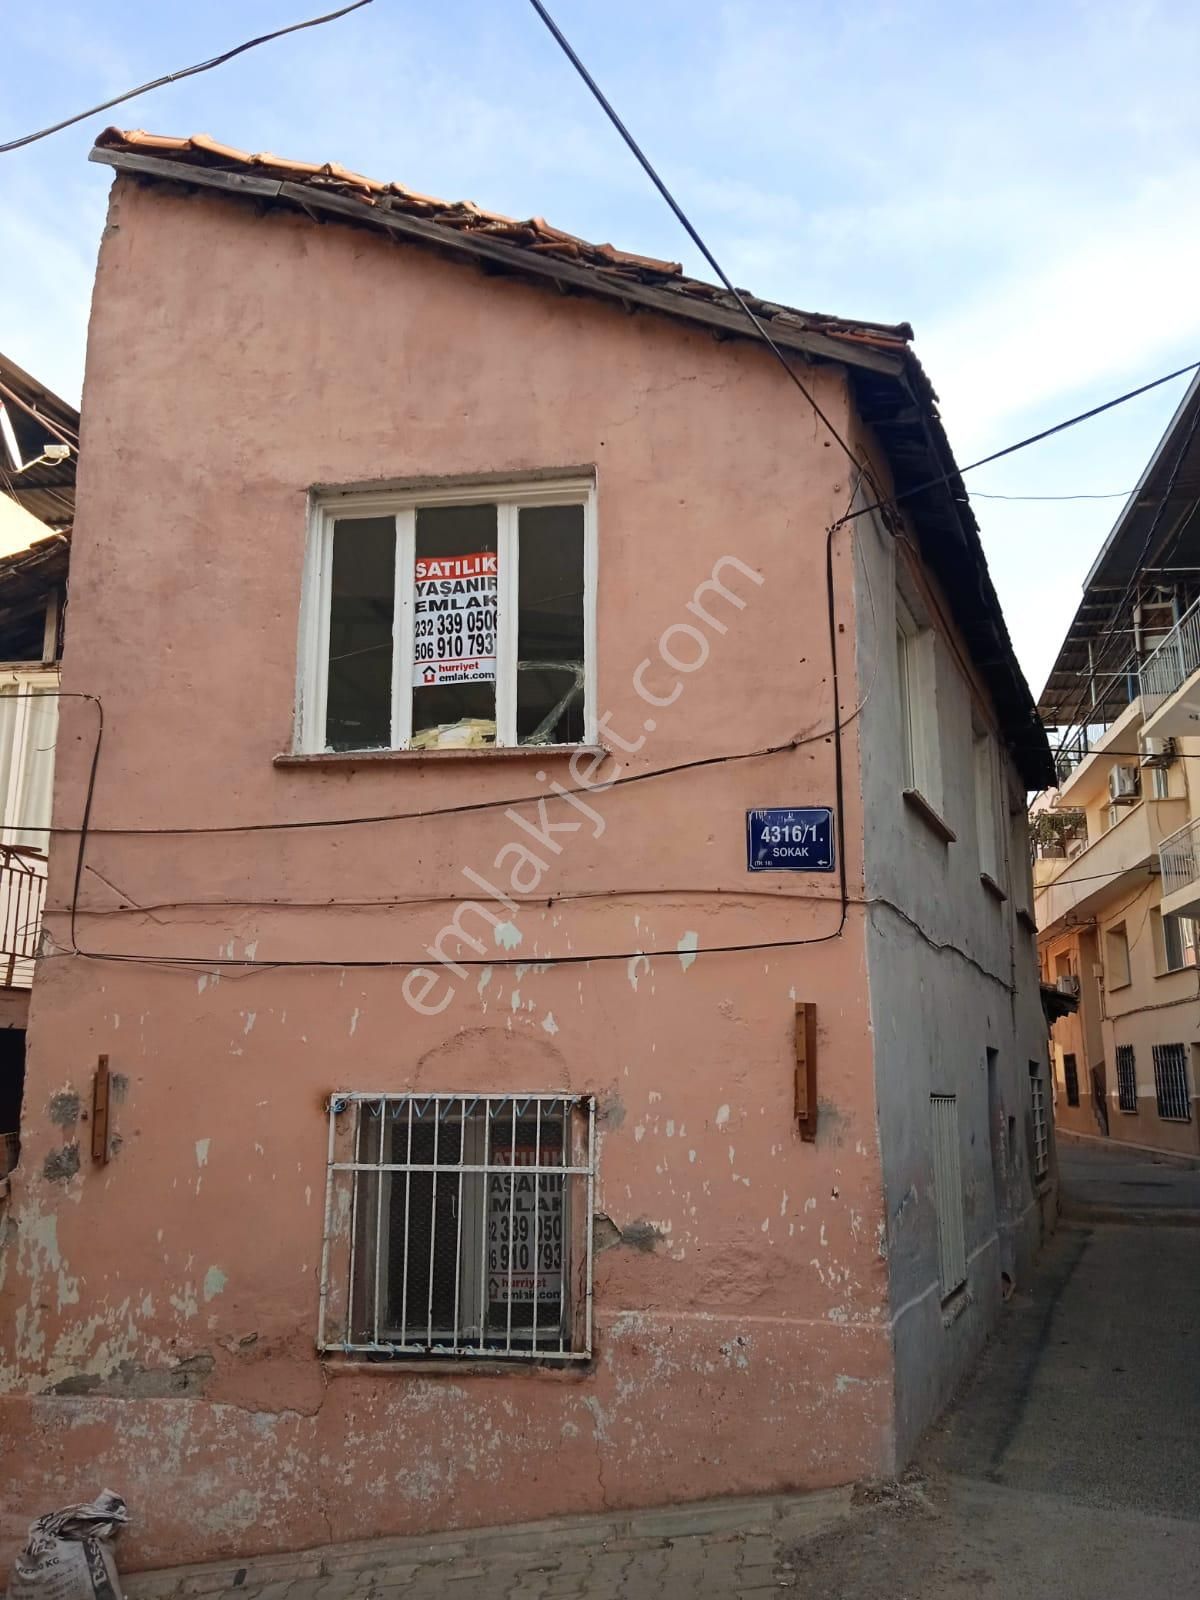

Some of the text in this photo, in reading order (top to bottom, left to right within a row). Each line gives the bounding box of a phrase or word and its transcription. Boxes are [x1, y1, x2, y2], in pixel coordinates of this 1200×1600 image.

[416, 557, 497, 577] SATILIK
[415, 595, 497, 614] EMLAK
[437, 613, 462, 635] 339
[438, 636, 463, 658] 910
[468, 633, 497, 655] 793
[439, 661, 479, 674] hurriyet
[439, 671, 495, 681] emlak.com
[760, 824, 823, 844] 4316/1.
[773, 847, 809, 857] SOKAK
[500, 1215, 529, 1242] 339
